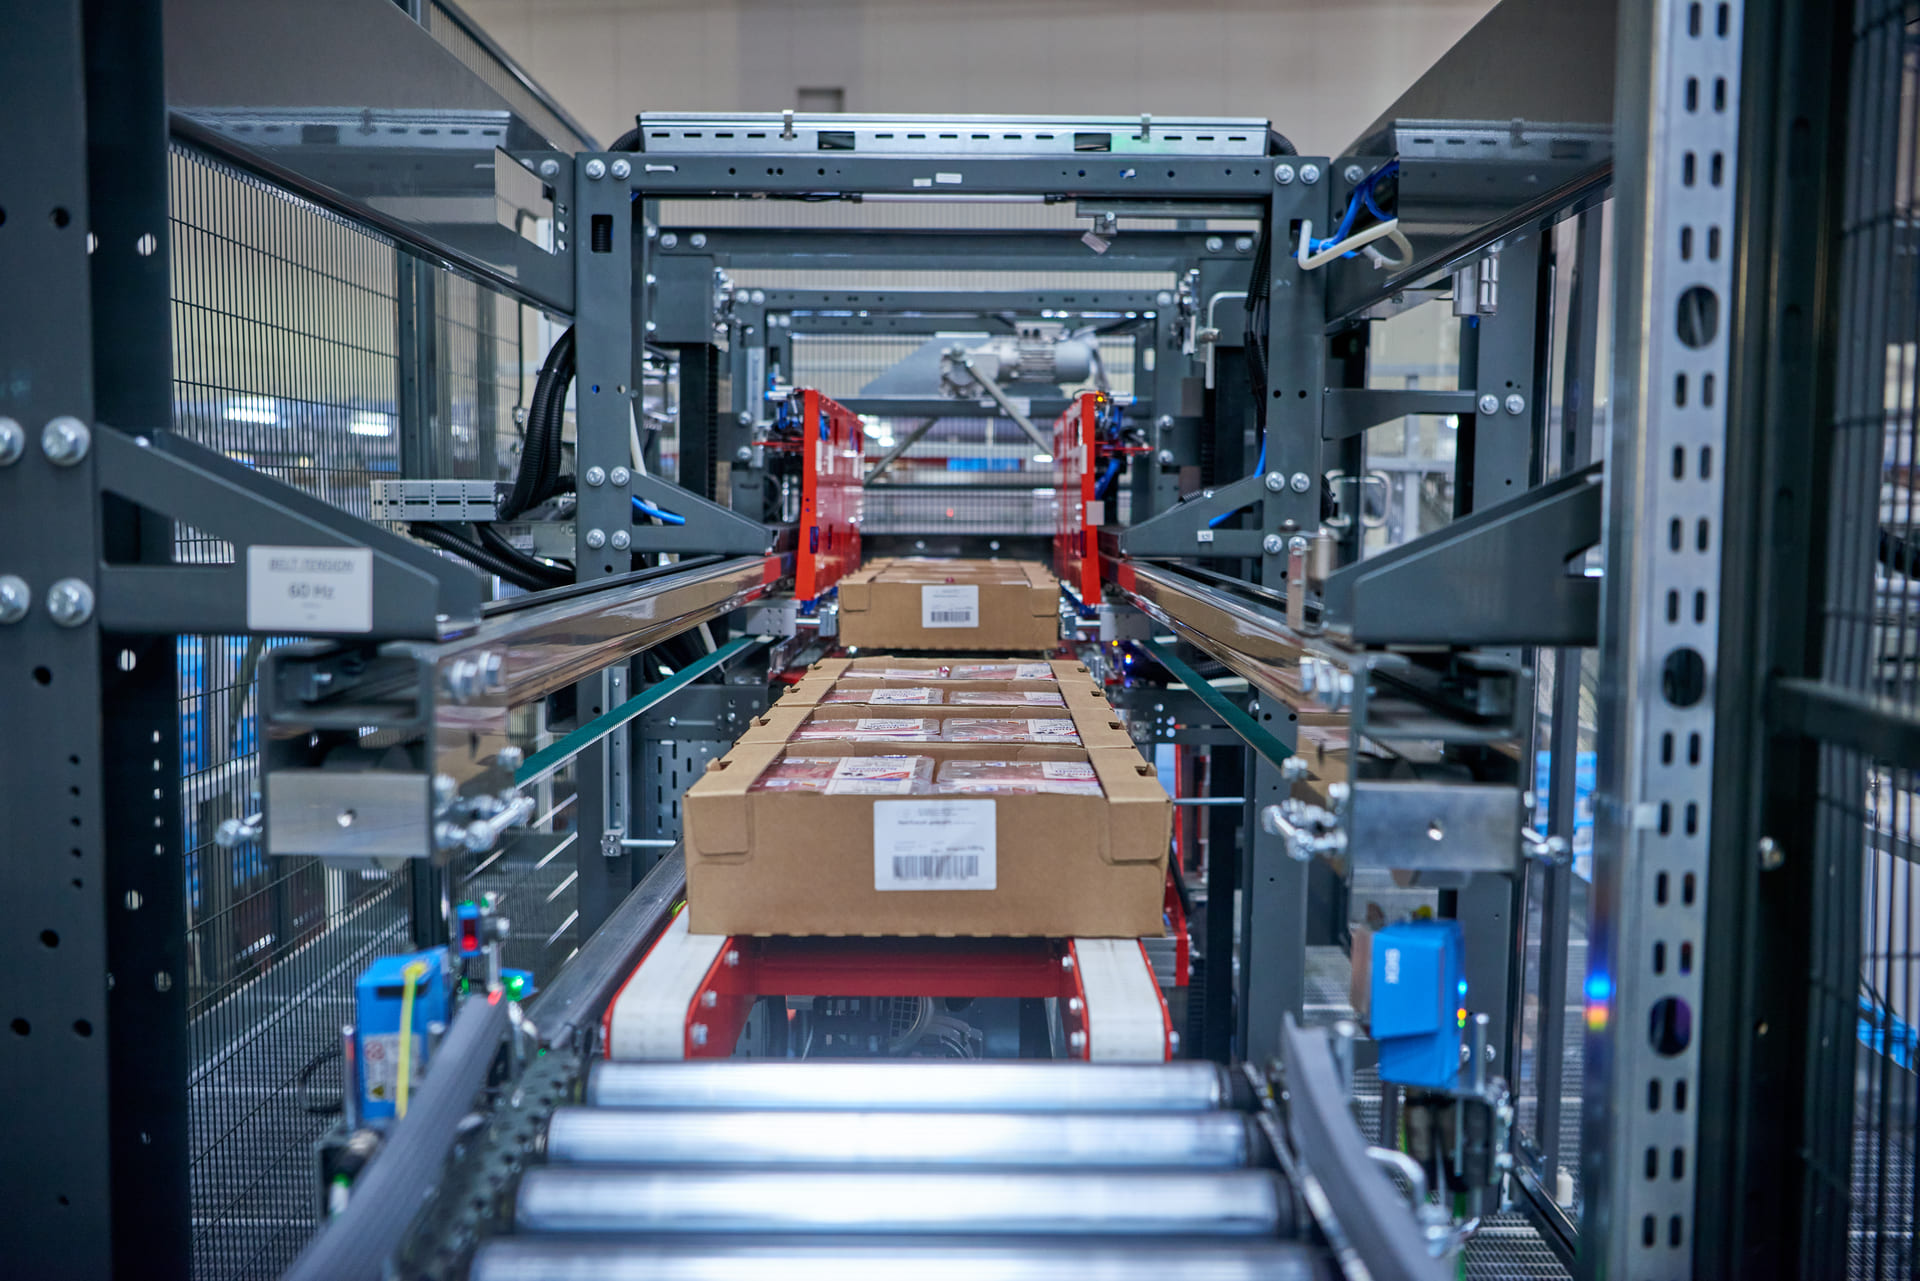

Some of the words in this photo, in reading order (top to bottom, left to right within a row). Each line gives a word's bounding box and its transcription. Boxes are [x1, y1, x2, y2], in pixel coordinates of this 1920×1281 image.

[269, 558, 298, 572] BELT
[303, 558, 354, 573] TENSION
[288, 583, 311, 599] 60
[313, 584, 335, 600] Hz
